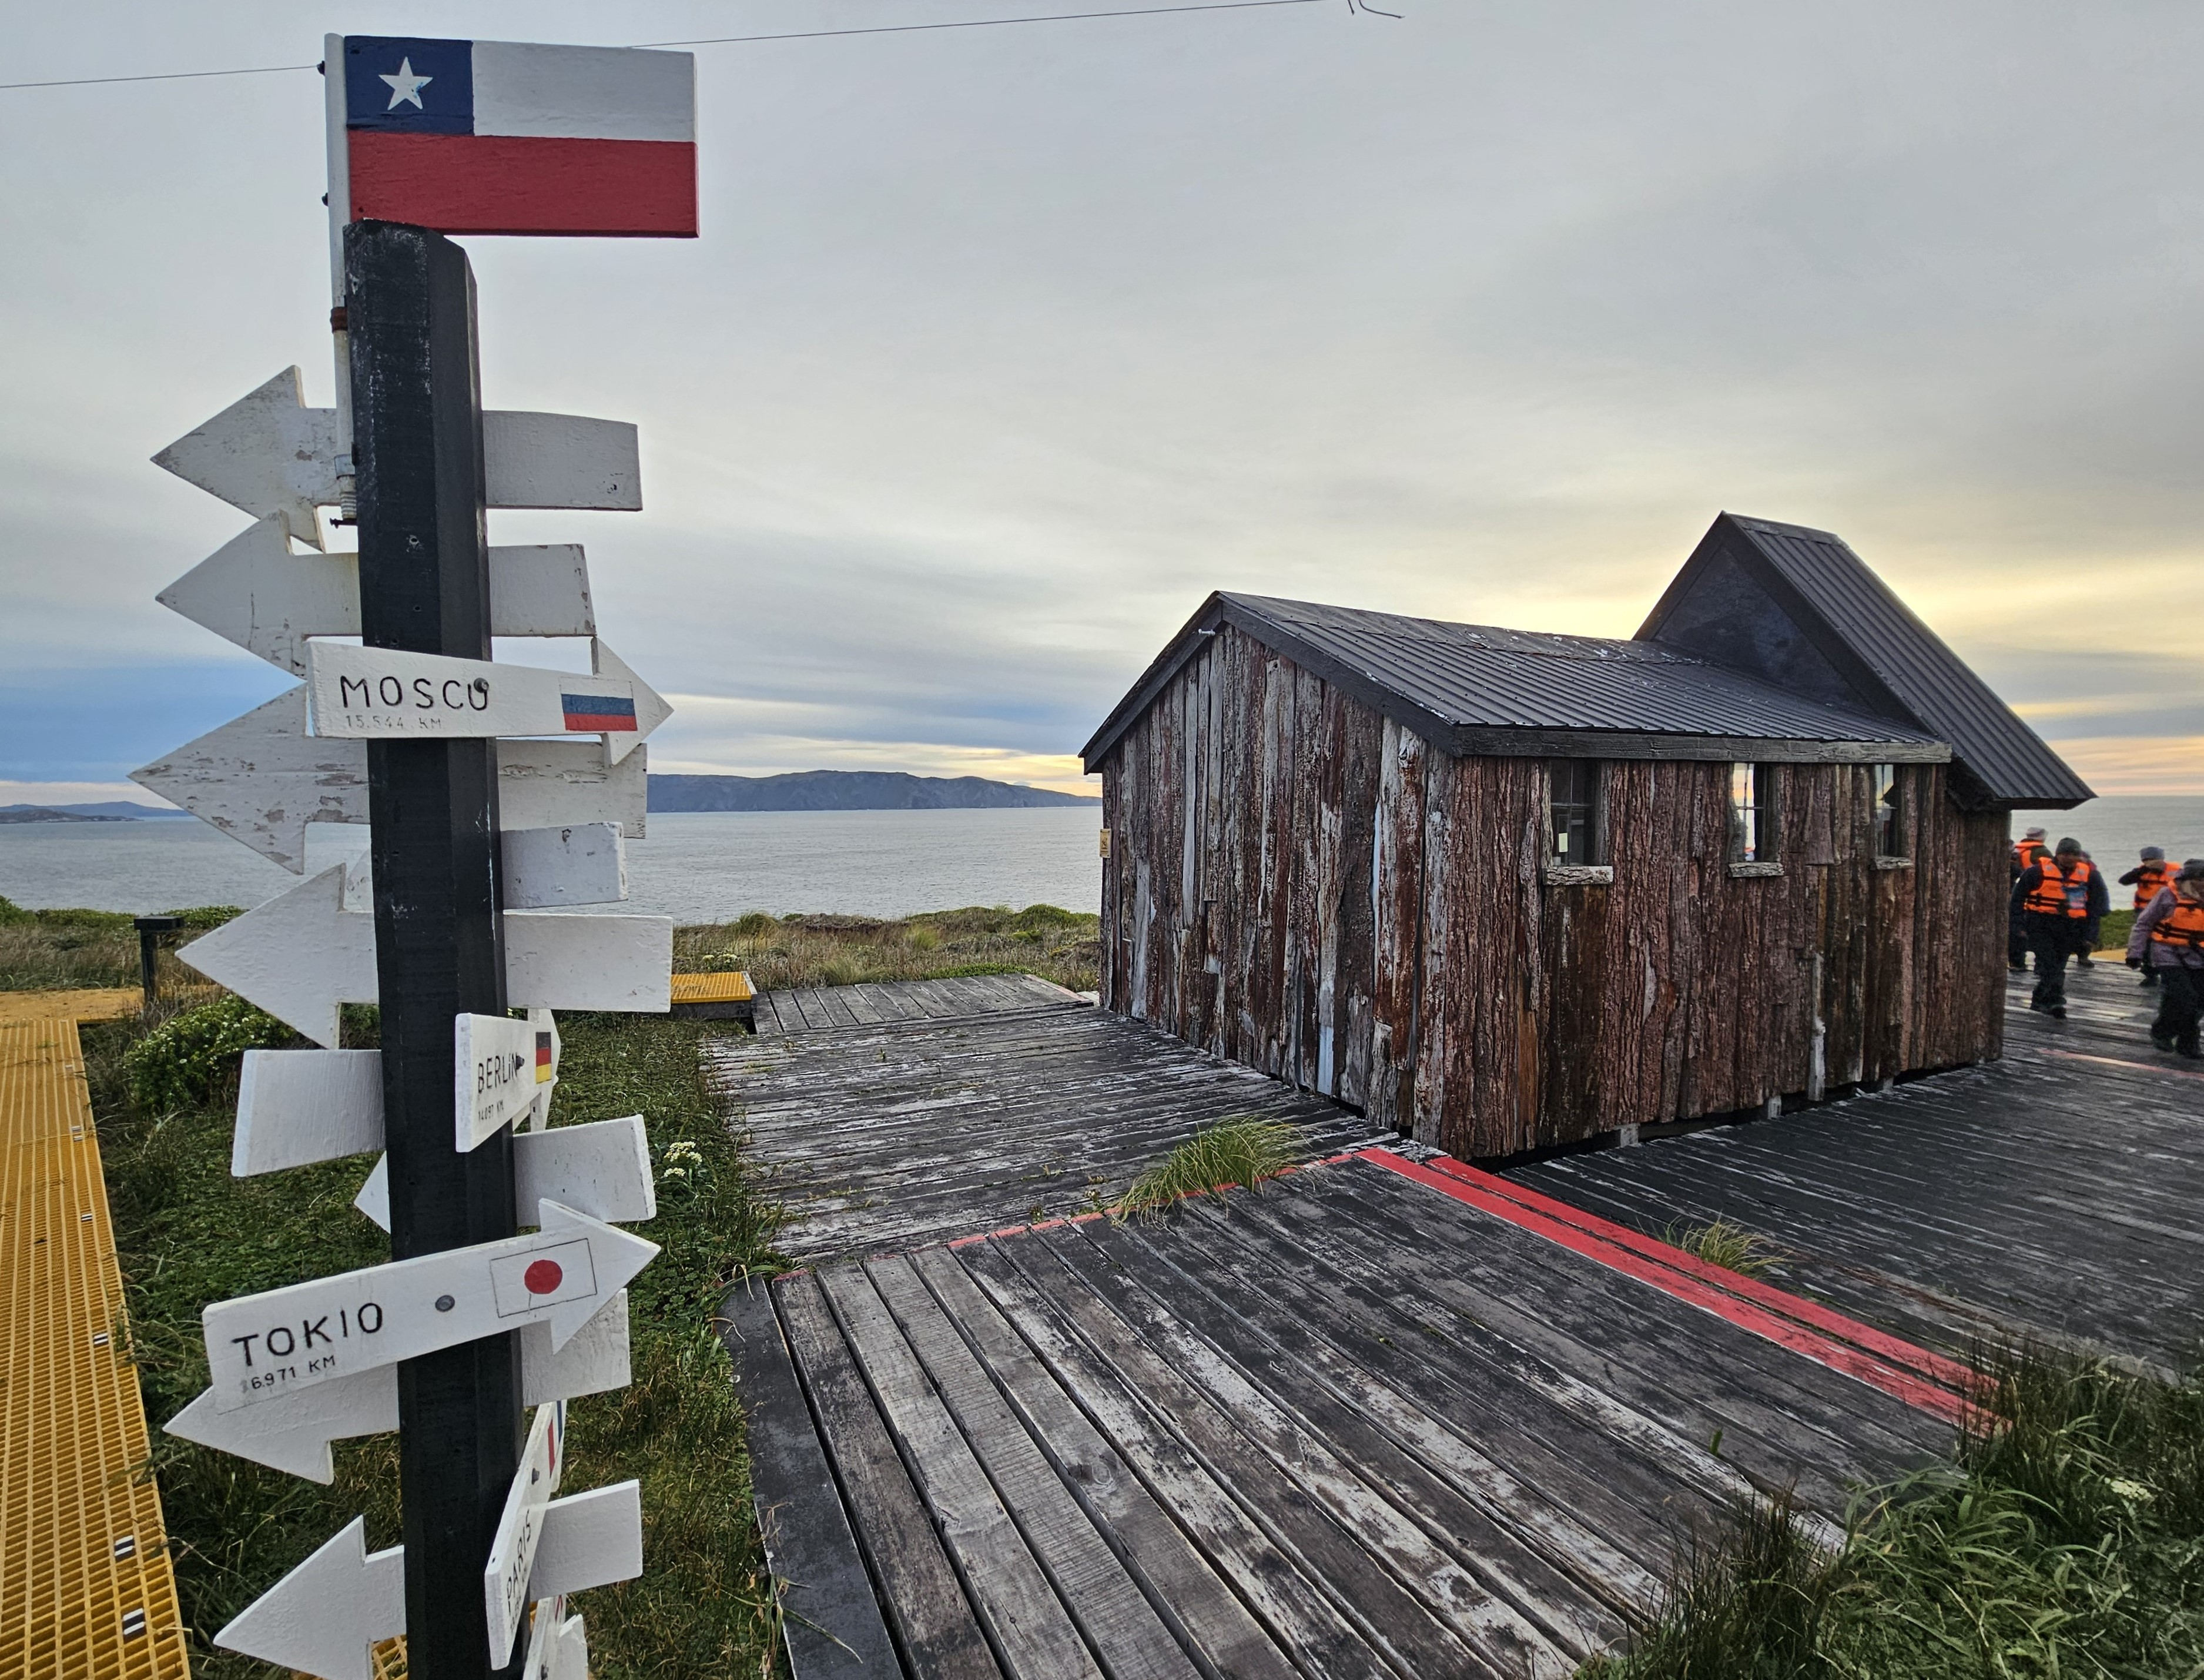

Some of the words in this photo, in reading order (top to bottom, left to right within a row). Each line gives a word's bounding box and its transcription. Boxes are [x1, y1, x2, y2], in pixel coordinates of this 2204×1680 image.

[340, 675, 488, 711] MOSCU
[418, 717, 441, 729] KM
[231, 1302, 383, 1367] TOKIO
[309, 1355, 336, 1373] KM
[507, 1508, 531, 1617] PARIS
